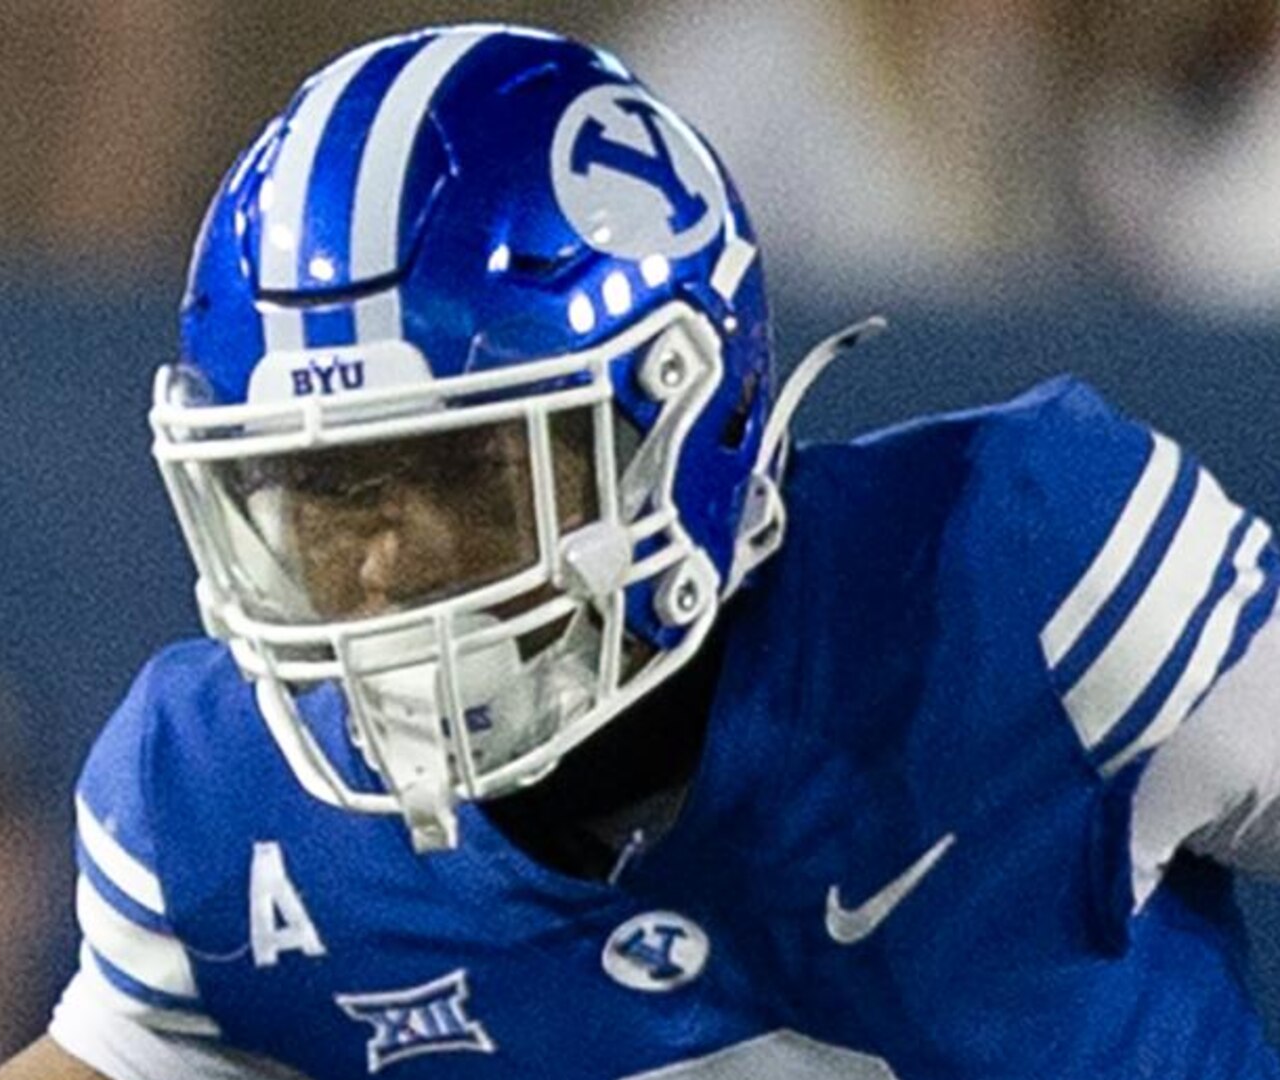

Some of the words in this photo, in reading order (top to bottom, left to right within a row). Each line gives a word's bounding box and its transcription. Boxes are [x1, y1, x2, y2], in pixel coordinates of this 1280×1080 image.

[570, 97, 709, 236] Y
[291, 354, 365, 397] BYU
[249, 841, 328, 967] A
